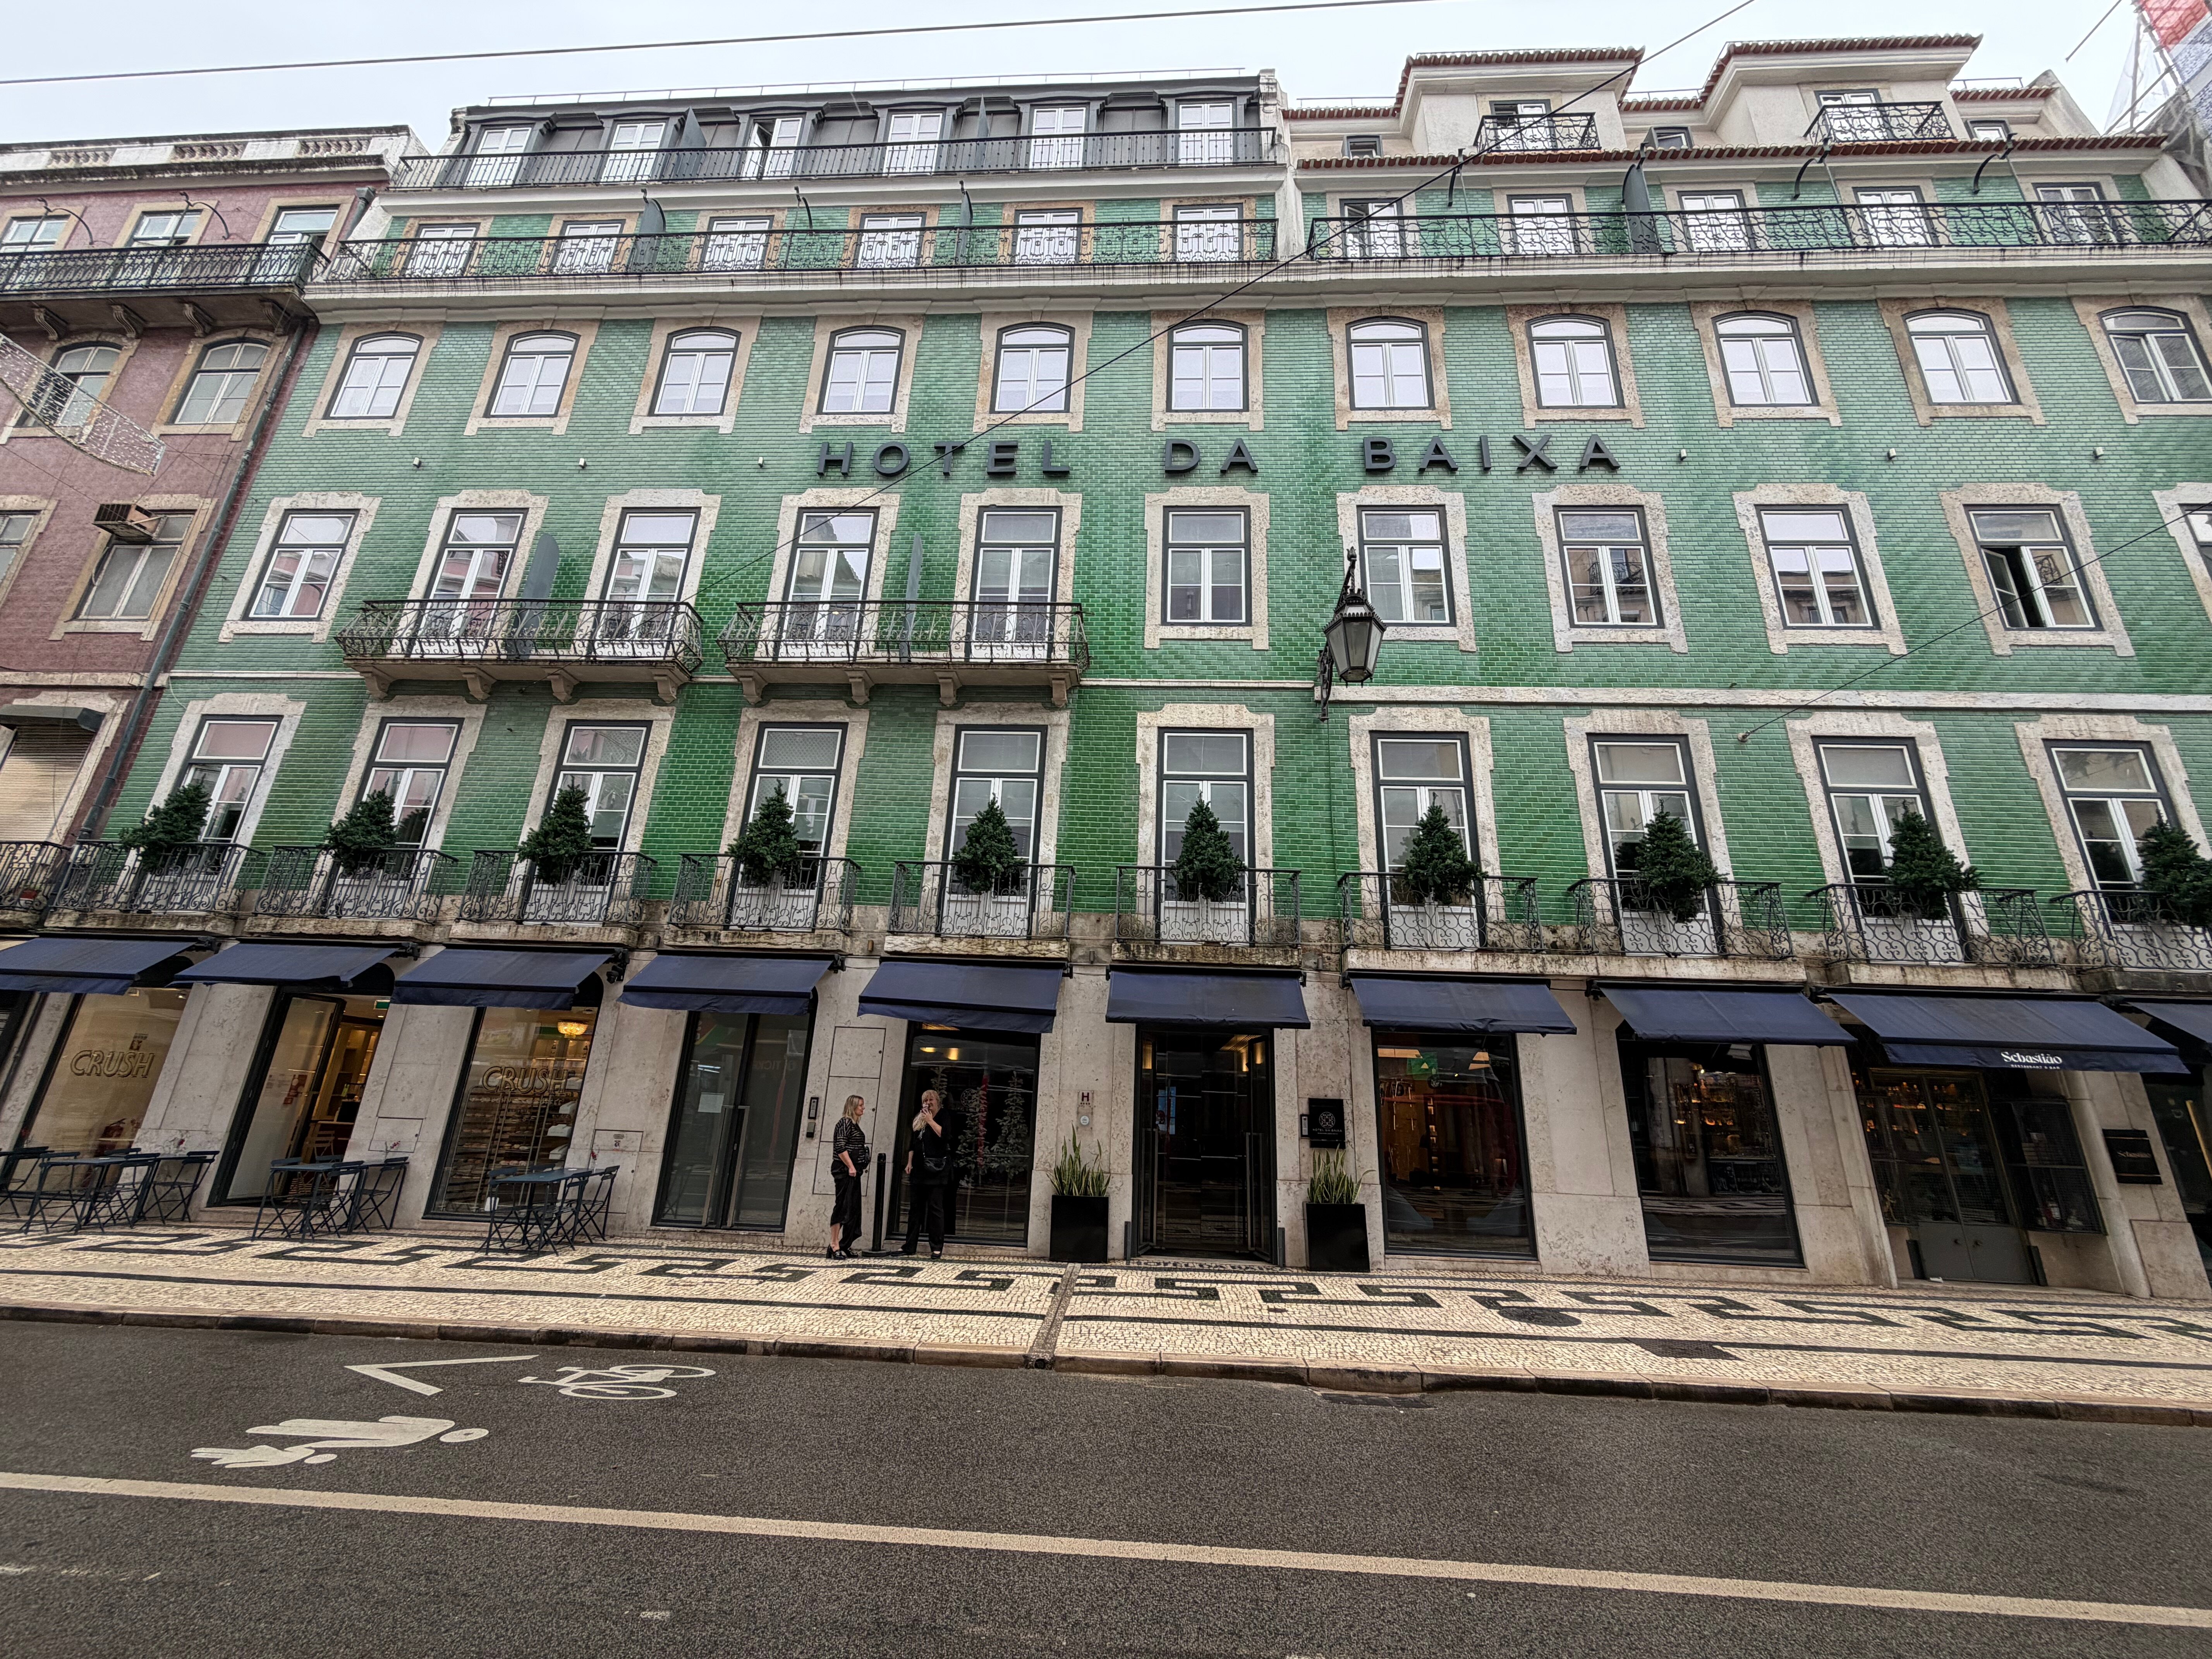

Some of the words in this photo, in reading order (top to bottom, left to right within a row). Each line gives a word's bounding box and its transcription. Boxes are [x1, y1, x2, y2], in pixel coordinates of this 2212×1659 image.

[817, 440, 1070, 476] HOTEL
[1164, 438, 1258, 474] DA
[1363, 434, 1620, 472] BAIXA
[70, 1050, 155, 1078] CRUSH
[2001, 1052, 2062, 1064] Sebastião
[482, 1066, 568, 1096] CRUSH
[1082, 1092, 1089, 1101] H
